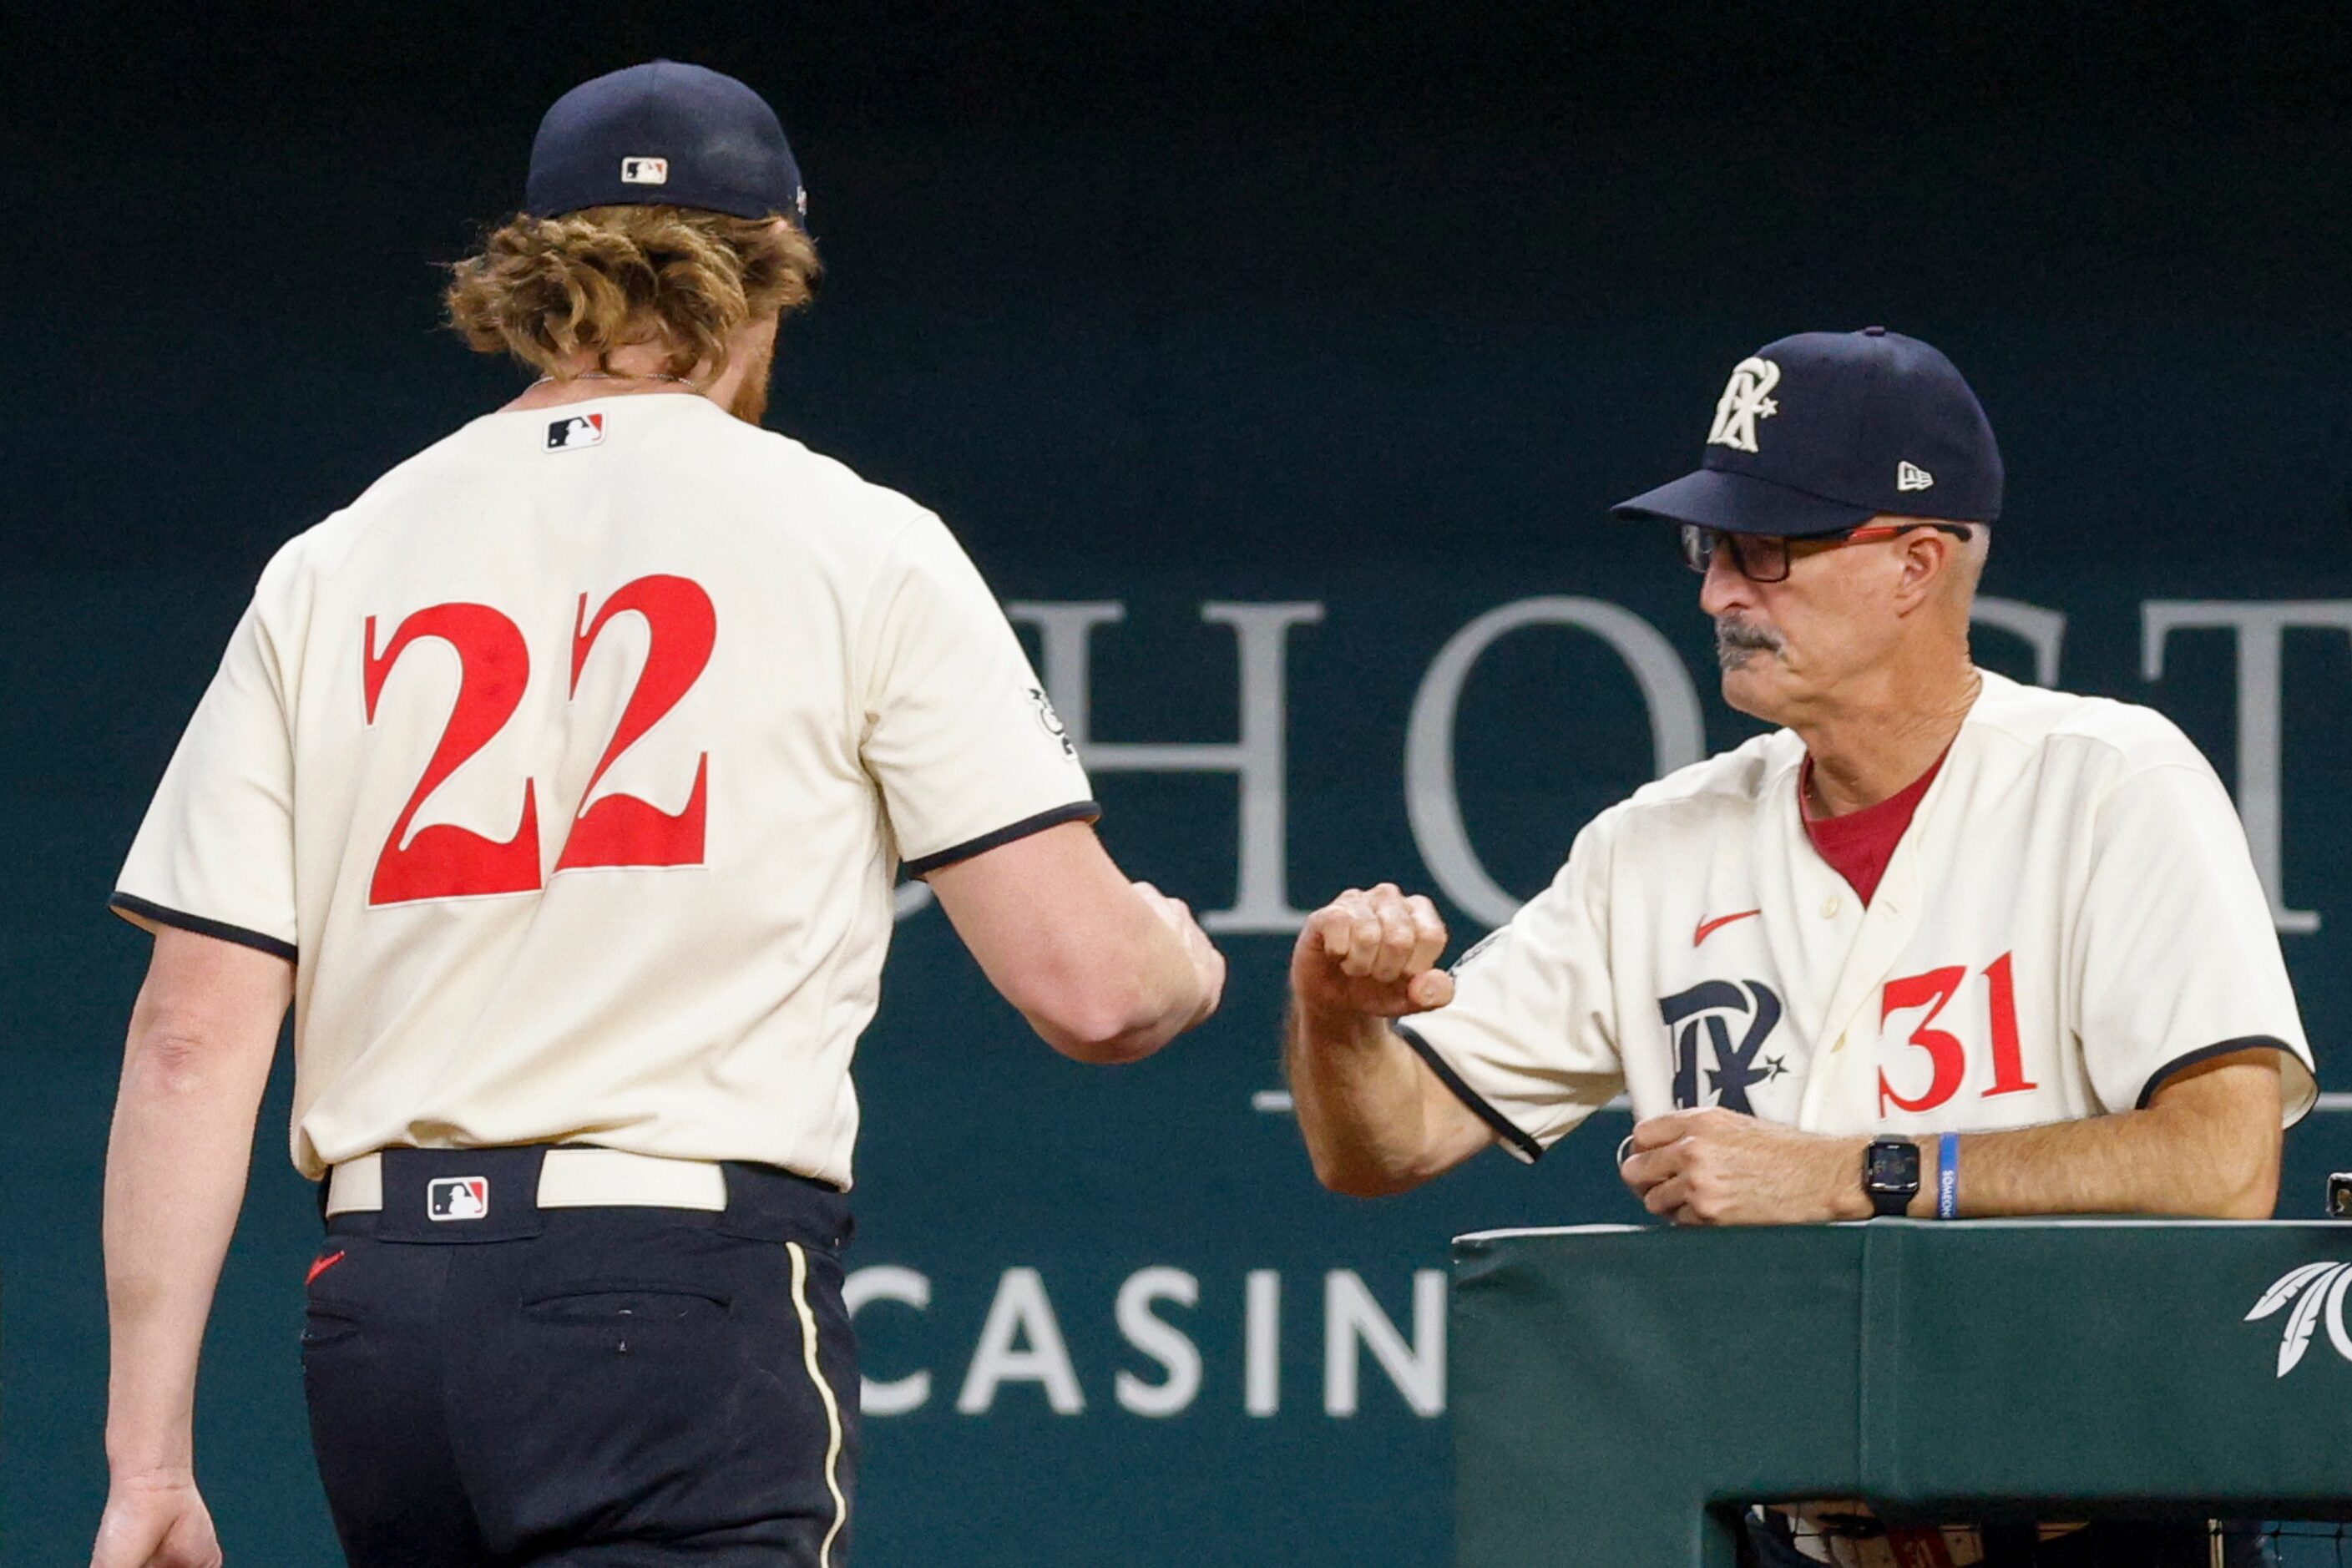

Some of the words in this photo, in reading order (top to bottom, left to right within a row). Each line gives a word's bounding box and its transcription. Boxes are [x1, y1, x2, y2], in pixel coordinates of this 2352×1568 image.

[362, 573, 717, 908] 22
[1878, 949, 2039, 1119] 31
[841, 1265, 1448, 1417] CASIN
